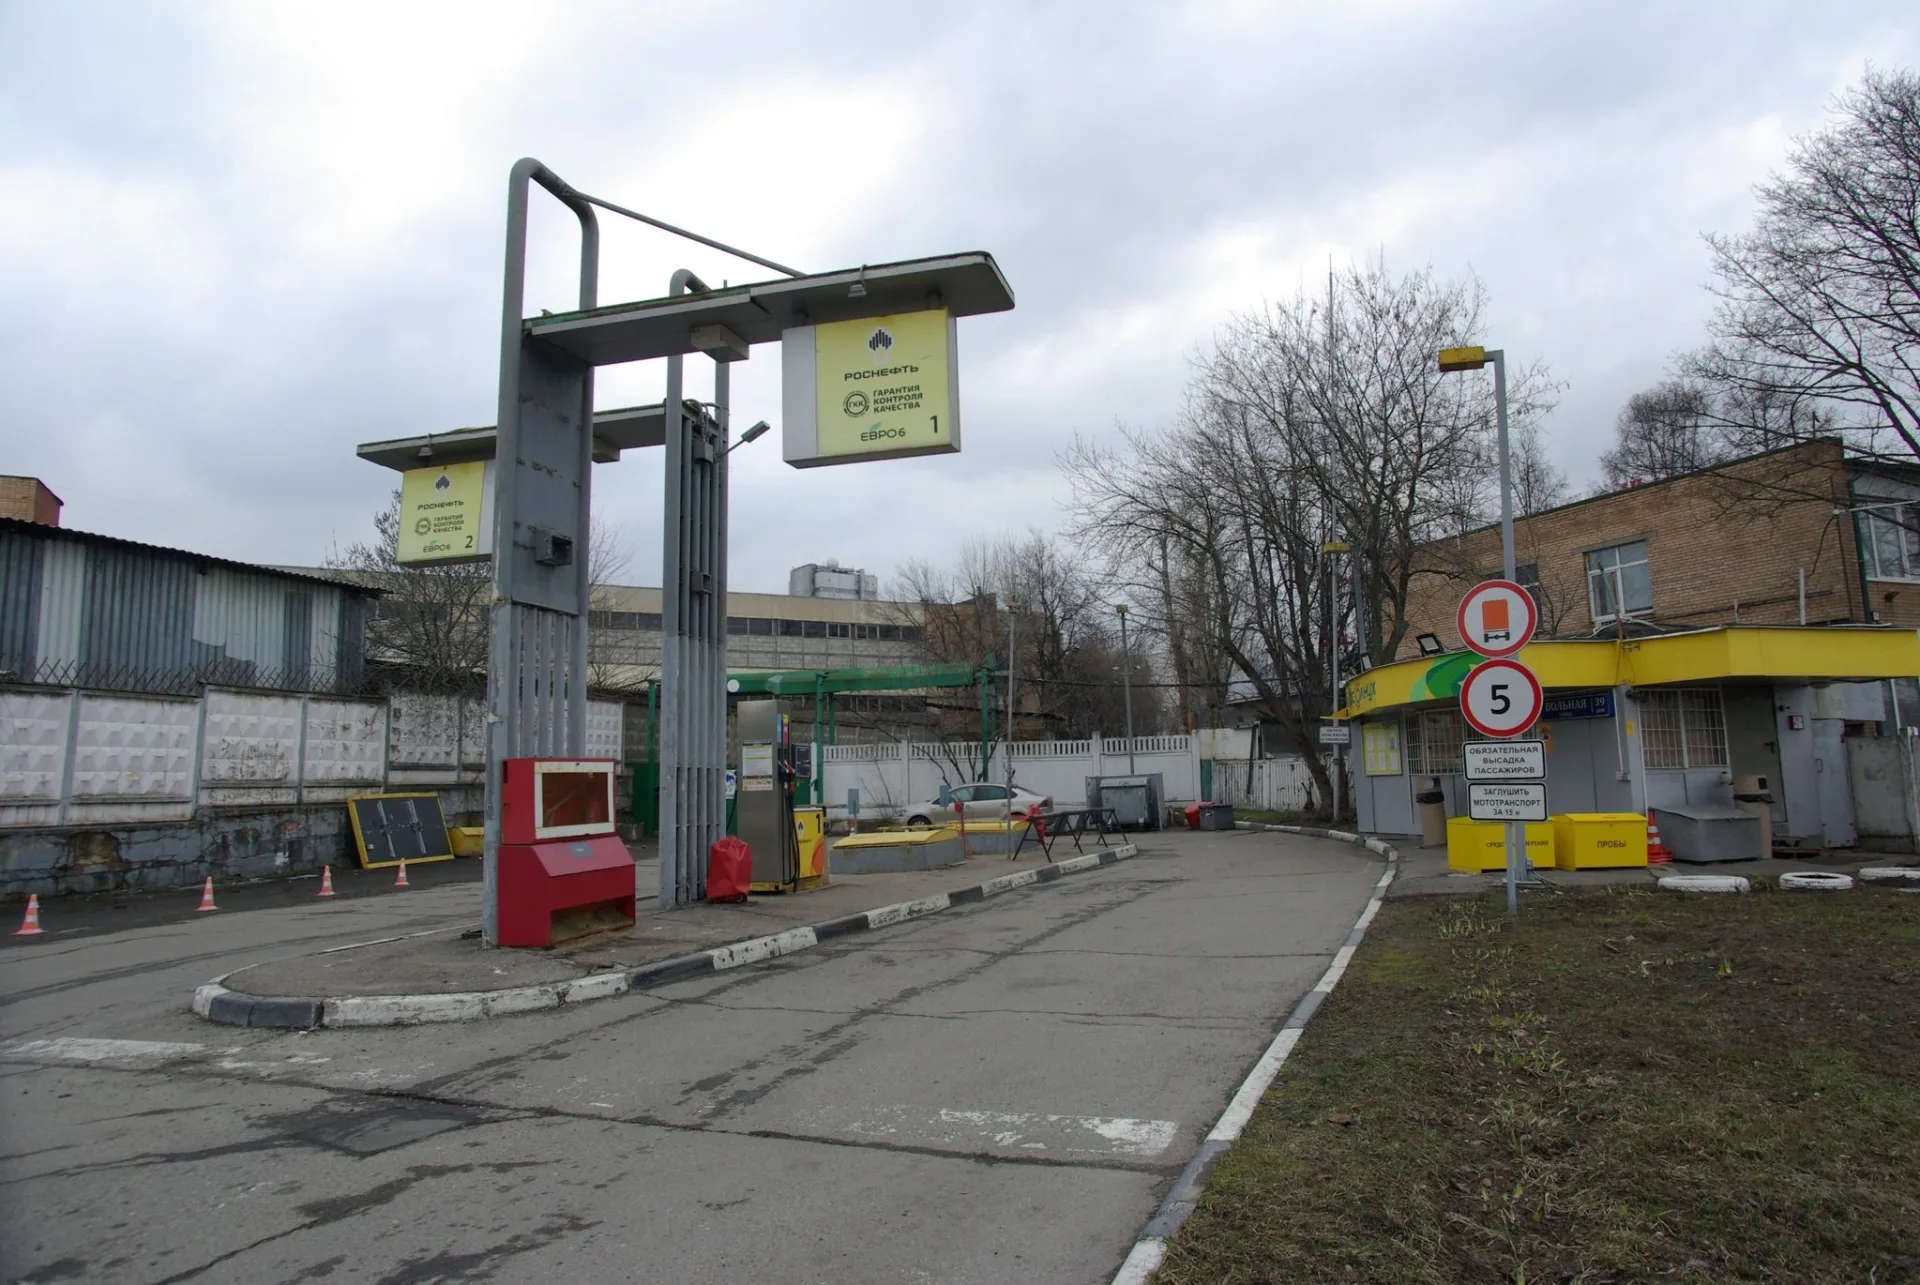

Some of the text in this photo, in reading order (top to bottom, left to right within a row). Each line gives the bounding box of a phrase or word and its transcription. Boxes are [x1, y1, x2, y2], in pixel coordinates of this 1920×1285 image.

[844, 365, 919, 381] РОСНЕФТЬ
[873, 384, 920, 397] ГАРАНТИЯ
[873, 392, 923, 405] КОНТРОЛЯ
[873, 401, 921, 414] КАЧЕСТВА
[930, 415, 939, 434] 1
[418, 501, 464, 511] РОСНЕФТЬ
[464, 535, 473, 548] 2
[1490, 684, 1511, 715] 5
[1545, 698, 1587, 711] ВОЛЬНАЯ
[1594, 697, 1605, 707] 39
[1469, 746, 1538, 755] ОБЯЗАТЕЛЬНАЯ
[1483, 757, 1526, 765] ВЫСАДКА
[1474, 766, 1535, 774] ПАССАЖИРОВ
[1483, 788, 1529, 796] ЗАГЛУШИТЬ
[1473, 799, 1541, 807] МОТОТРАНСПОРТ
[1505, 808, 1513, 816] 15
[816, 813, 822, 834] 1
[1597, 840, 1627, 849] ПРОБЫ
